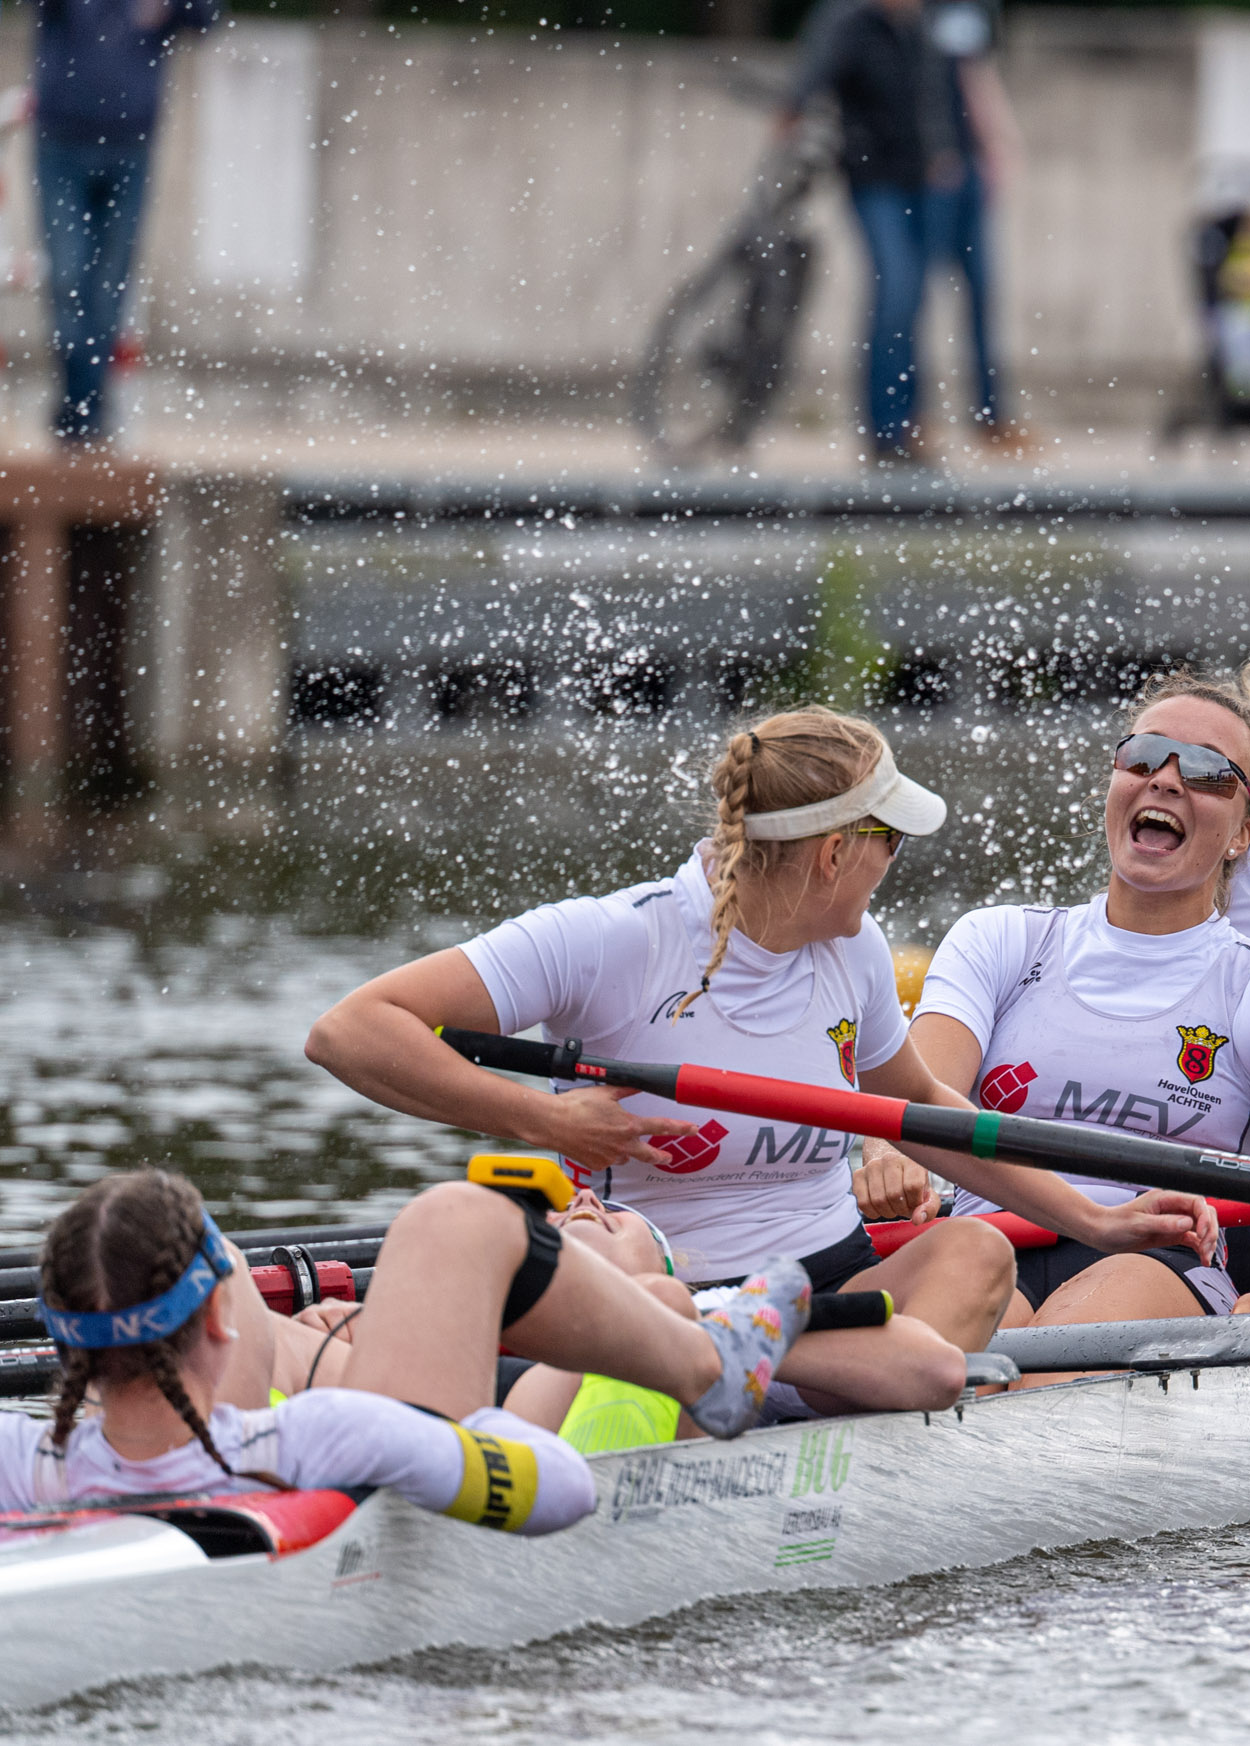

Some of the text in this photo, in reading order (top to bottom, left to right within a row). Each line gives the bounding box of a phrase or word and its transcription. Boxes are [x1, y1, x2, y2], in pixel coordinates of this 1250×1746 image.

[1053, 1079, 1206, 1137] MEV
[1158, 1079, 1222, 1105] HavelQueen
[1167, 1093, 1212, 1113] ACHTER
[111, 1303, 168, 1341] NK
